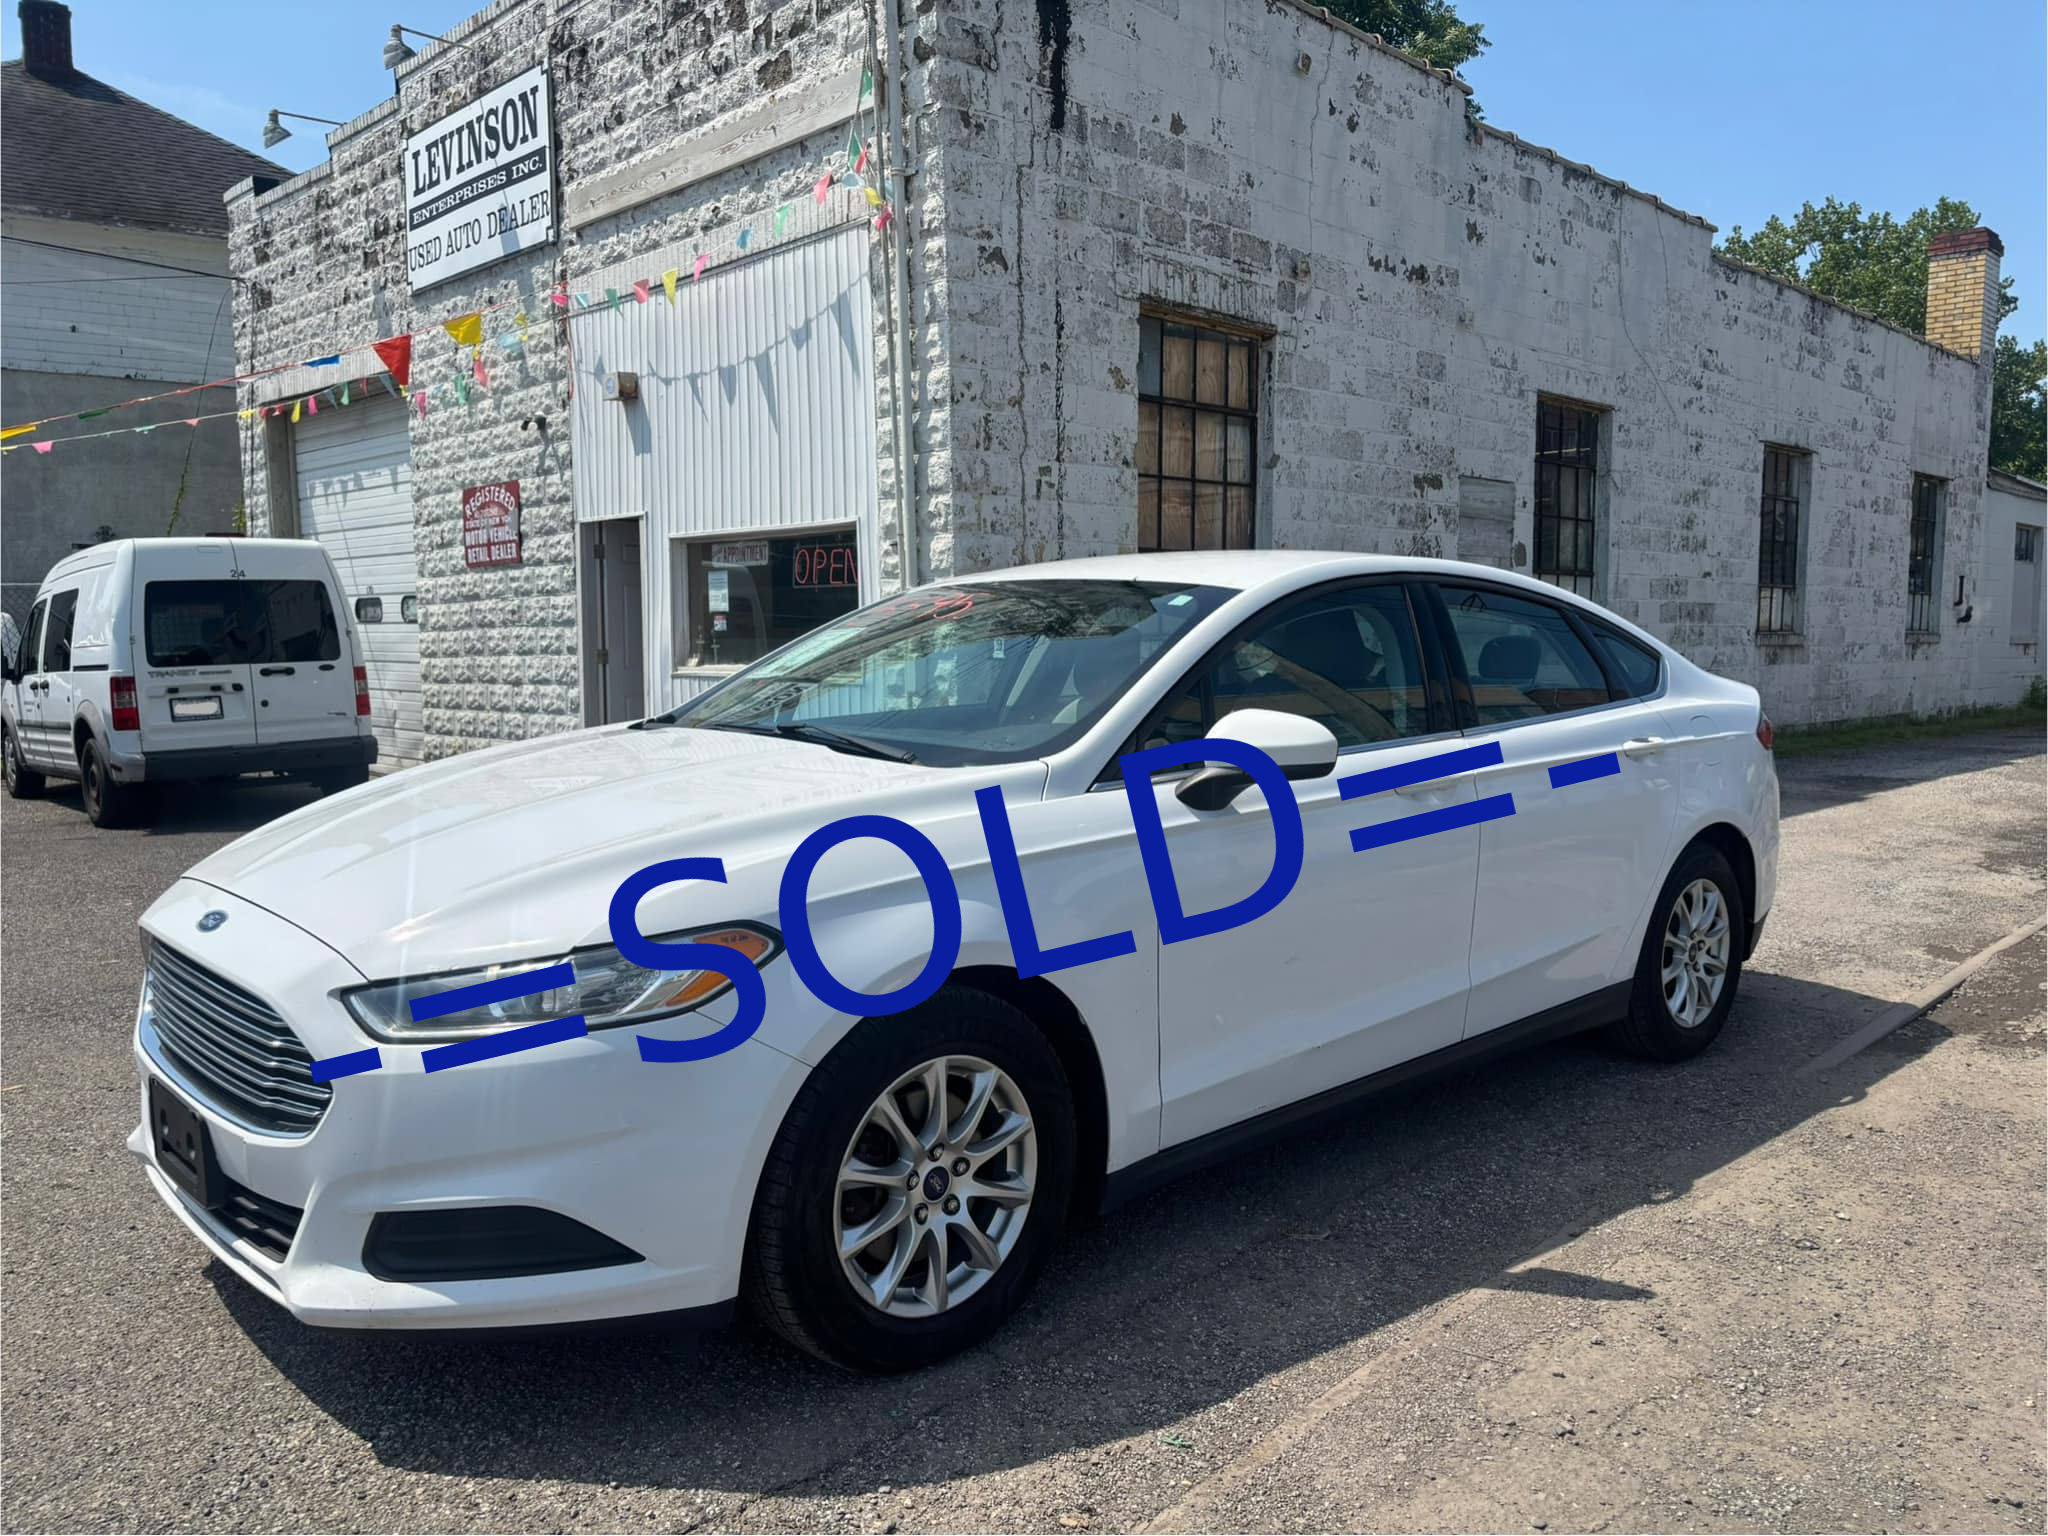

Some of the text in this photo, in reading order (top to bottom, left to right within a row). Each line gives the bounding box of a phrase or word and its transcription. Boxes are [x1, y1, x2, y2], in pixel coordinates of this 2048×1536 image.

[412, 84, 539, 198] LEVINSON
[412, 156, 543, 224] ENTERPRISES INC.
[409, 189, 549, 272] USED AUTO DEALER
[465, 486, 516, 518] REGISTERED
[491, 543, 516, 560] DEALER
[795, 548, 858, 585] OPEN
[230, 569, 245, 578] 24
